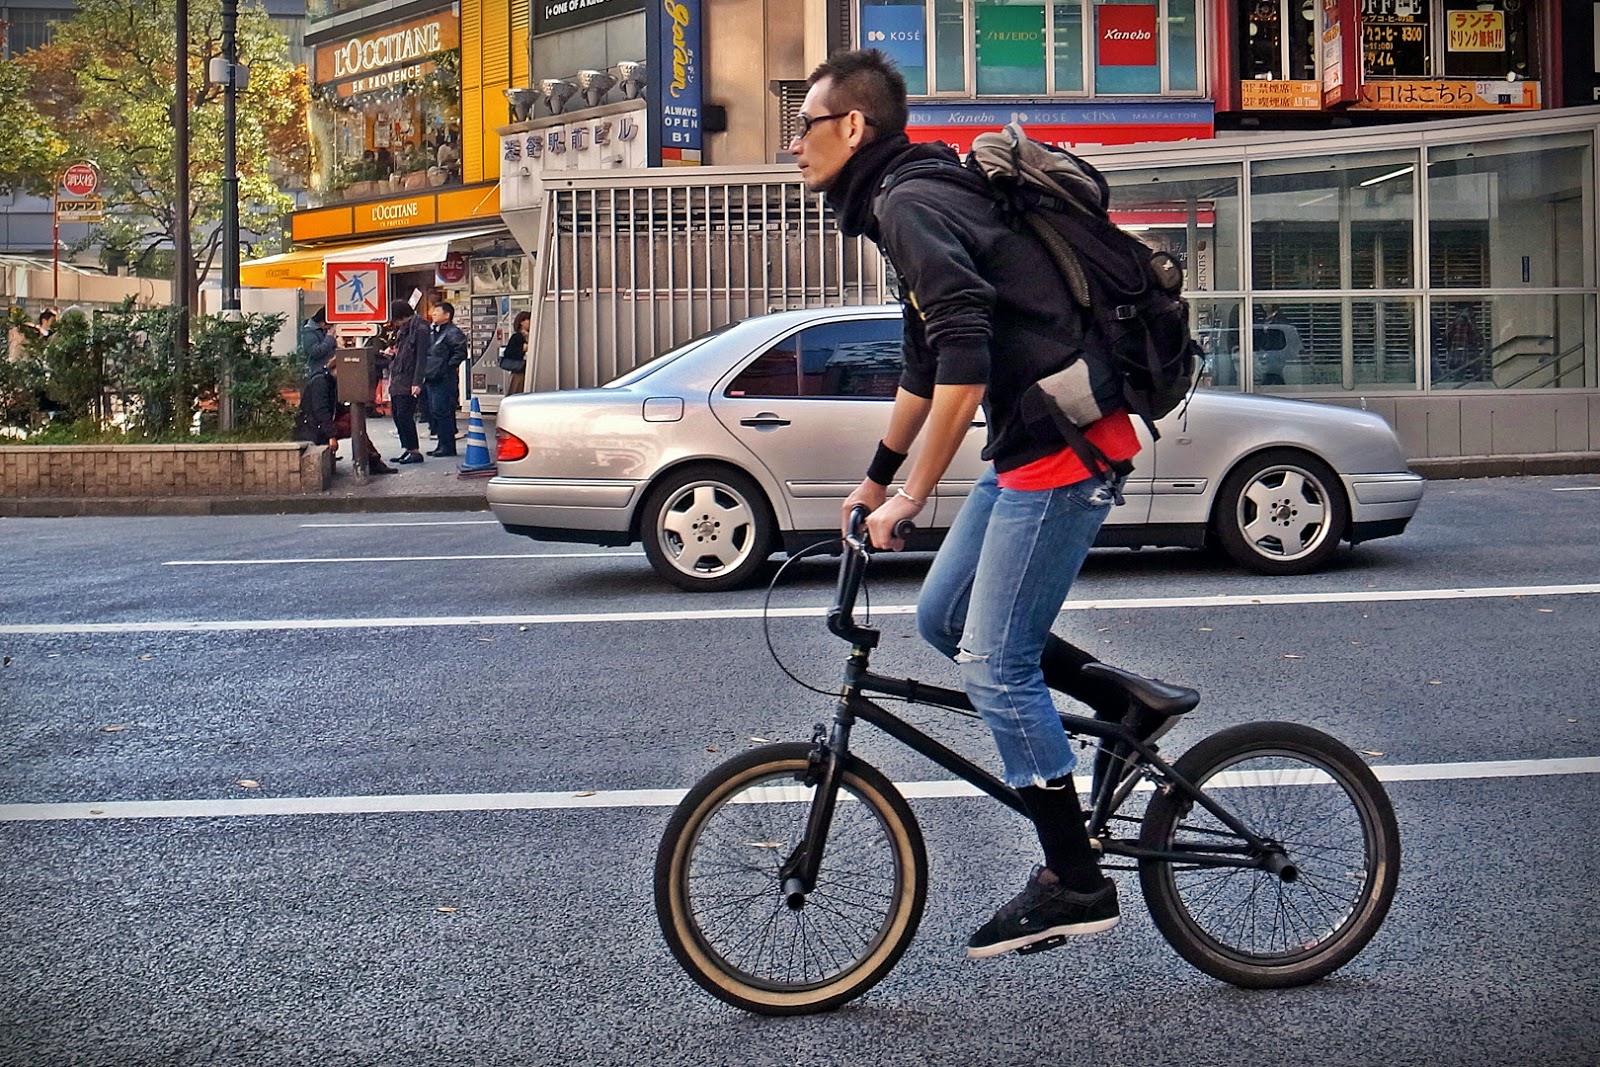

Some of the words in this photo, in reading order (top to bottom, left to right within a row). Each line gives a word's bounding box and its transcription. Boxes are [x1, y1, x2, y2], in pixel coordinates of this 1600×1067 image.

[552, 1, 568, 16] ONE
[1455, 13, 1496, 28] ランチ
[890, 30, 920, 41] KOSÉ
[986, 31, 1038, 41] SHISEIDO
[1104, 29, 1152, 40] Kanebo
[1401, 26, 1422, 41] ¥300
[334, 22, 441, 77] L'OCCITANE
[368, 65, 421, 89] PROVENCE
[1476, 83, 1491, 94] 2F
[664, 105, 698, 118] ALWAYS
[948, 111, 995, 123] Kanebo
[664, 117, 698, 129] OPEN
[504, 118, 639, 161] 渋谷駅前ビル
[672, 131, 691, 143] B1
[67, 173, 94, 187] 消火栓
[58, 202, 97, 211] パソコン
[371, 202, 419, 221] L'OCCITANE
